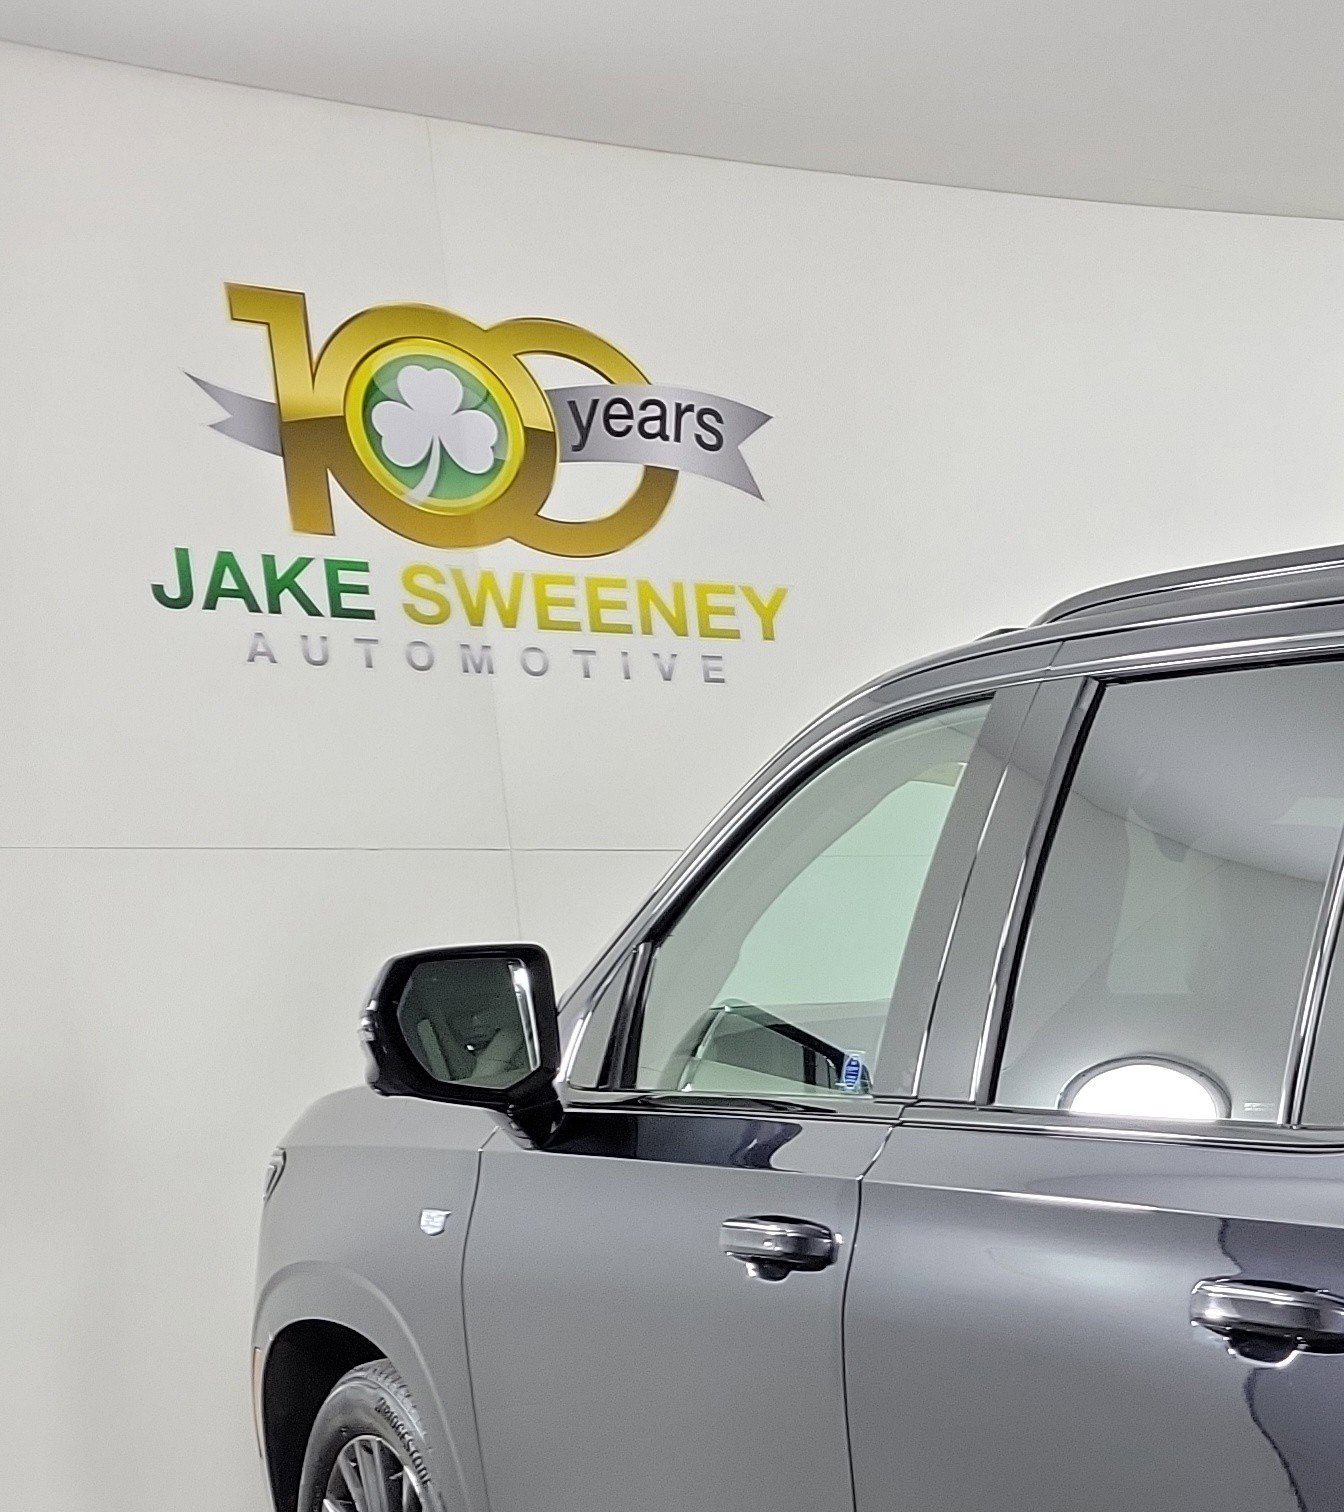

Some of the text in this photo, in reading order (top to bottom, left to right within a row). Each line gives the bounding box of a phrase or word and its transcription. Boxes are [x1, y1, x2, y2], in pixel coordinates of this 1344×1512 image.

[223, 281, 682, 558] 100
[566, 394, 724, 453] years
[150, 545, 790, 643] JAKE SWEENEY
[246, 631, 727, 685] AUTOMOTIVE
